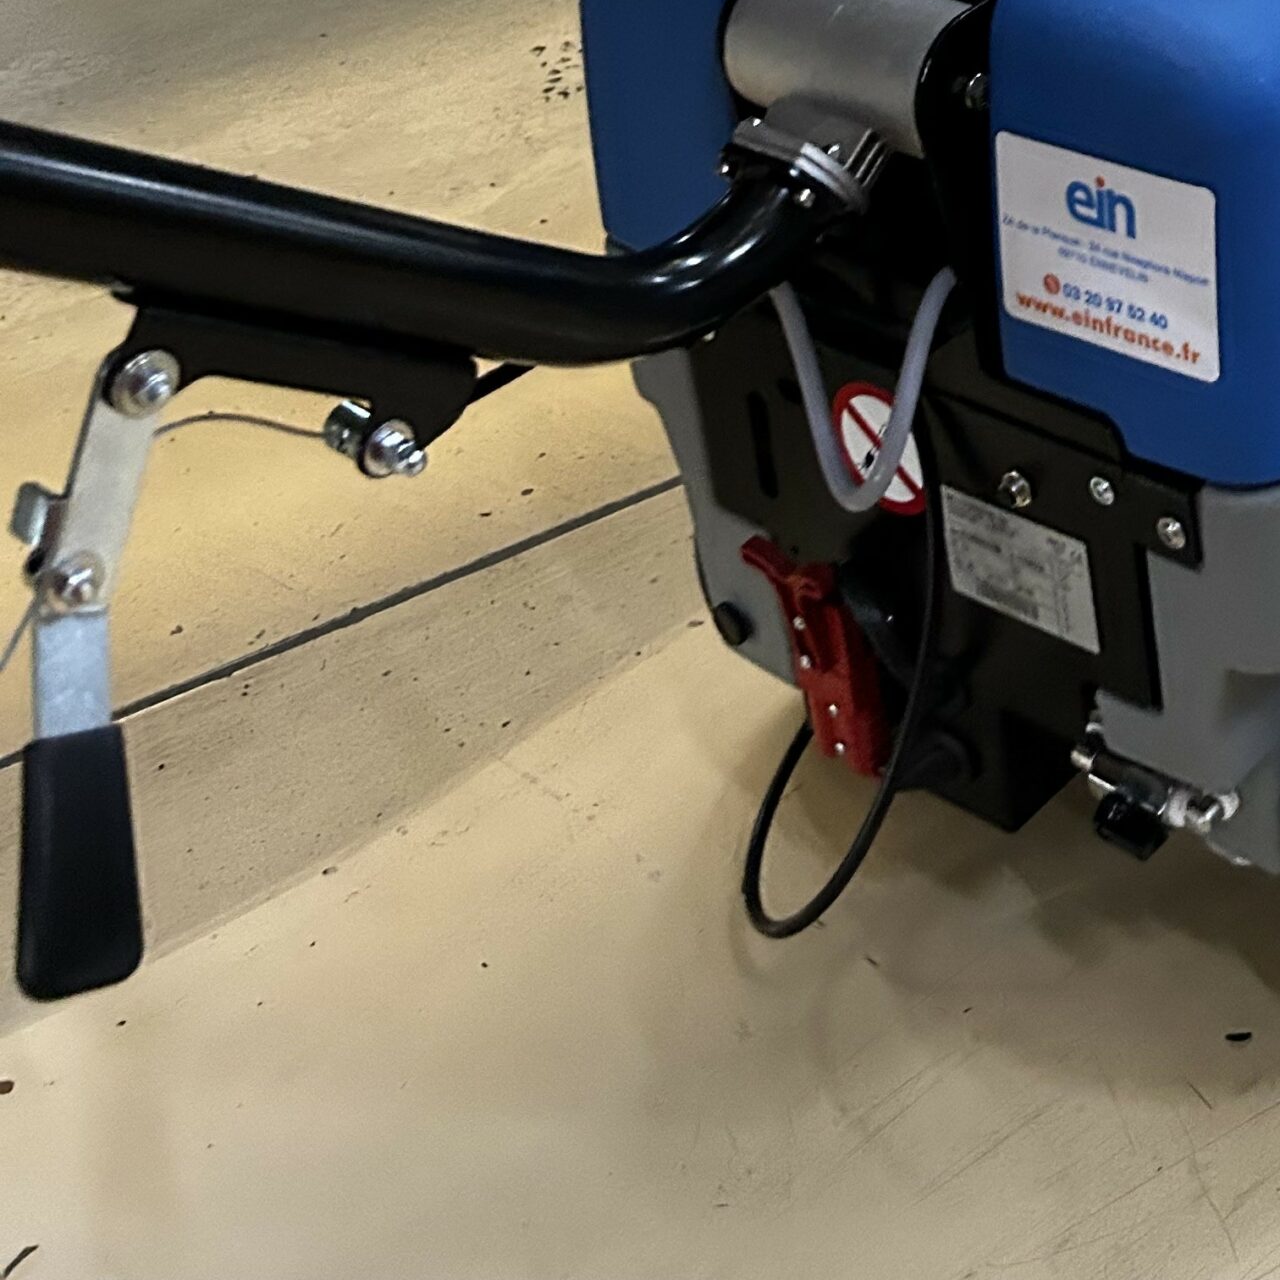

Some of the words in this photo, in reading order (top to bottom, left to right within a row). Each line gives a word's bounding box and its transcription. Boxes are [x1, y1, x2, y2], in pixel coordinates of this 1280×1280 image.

[1066, 176, 1136, 239] ein
[1016, 291, 1200, 364] www.einfrance.fr
[1063, 282, 1081, 301] 03
[1084, 289, 1101, 308] 20
[1150, 311, 1168, 330] 40
